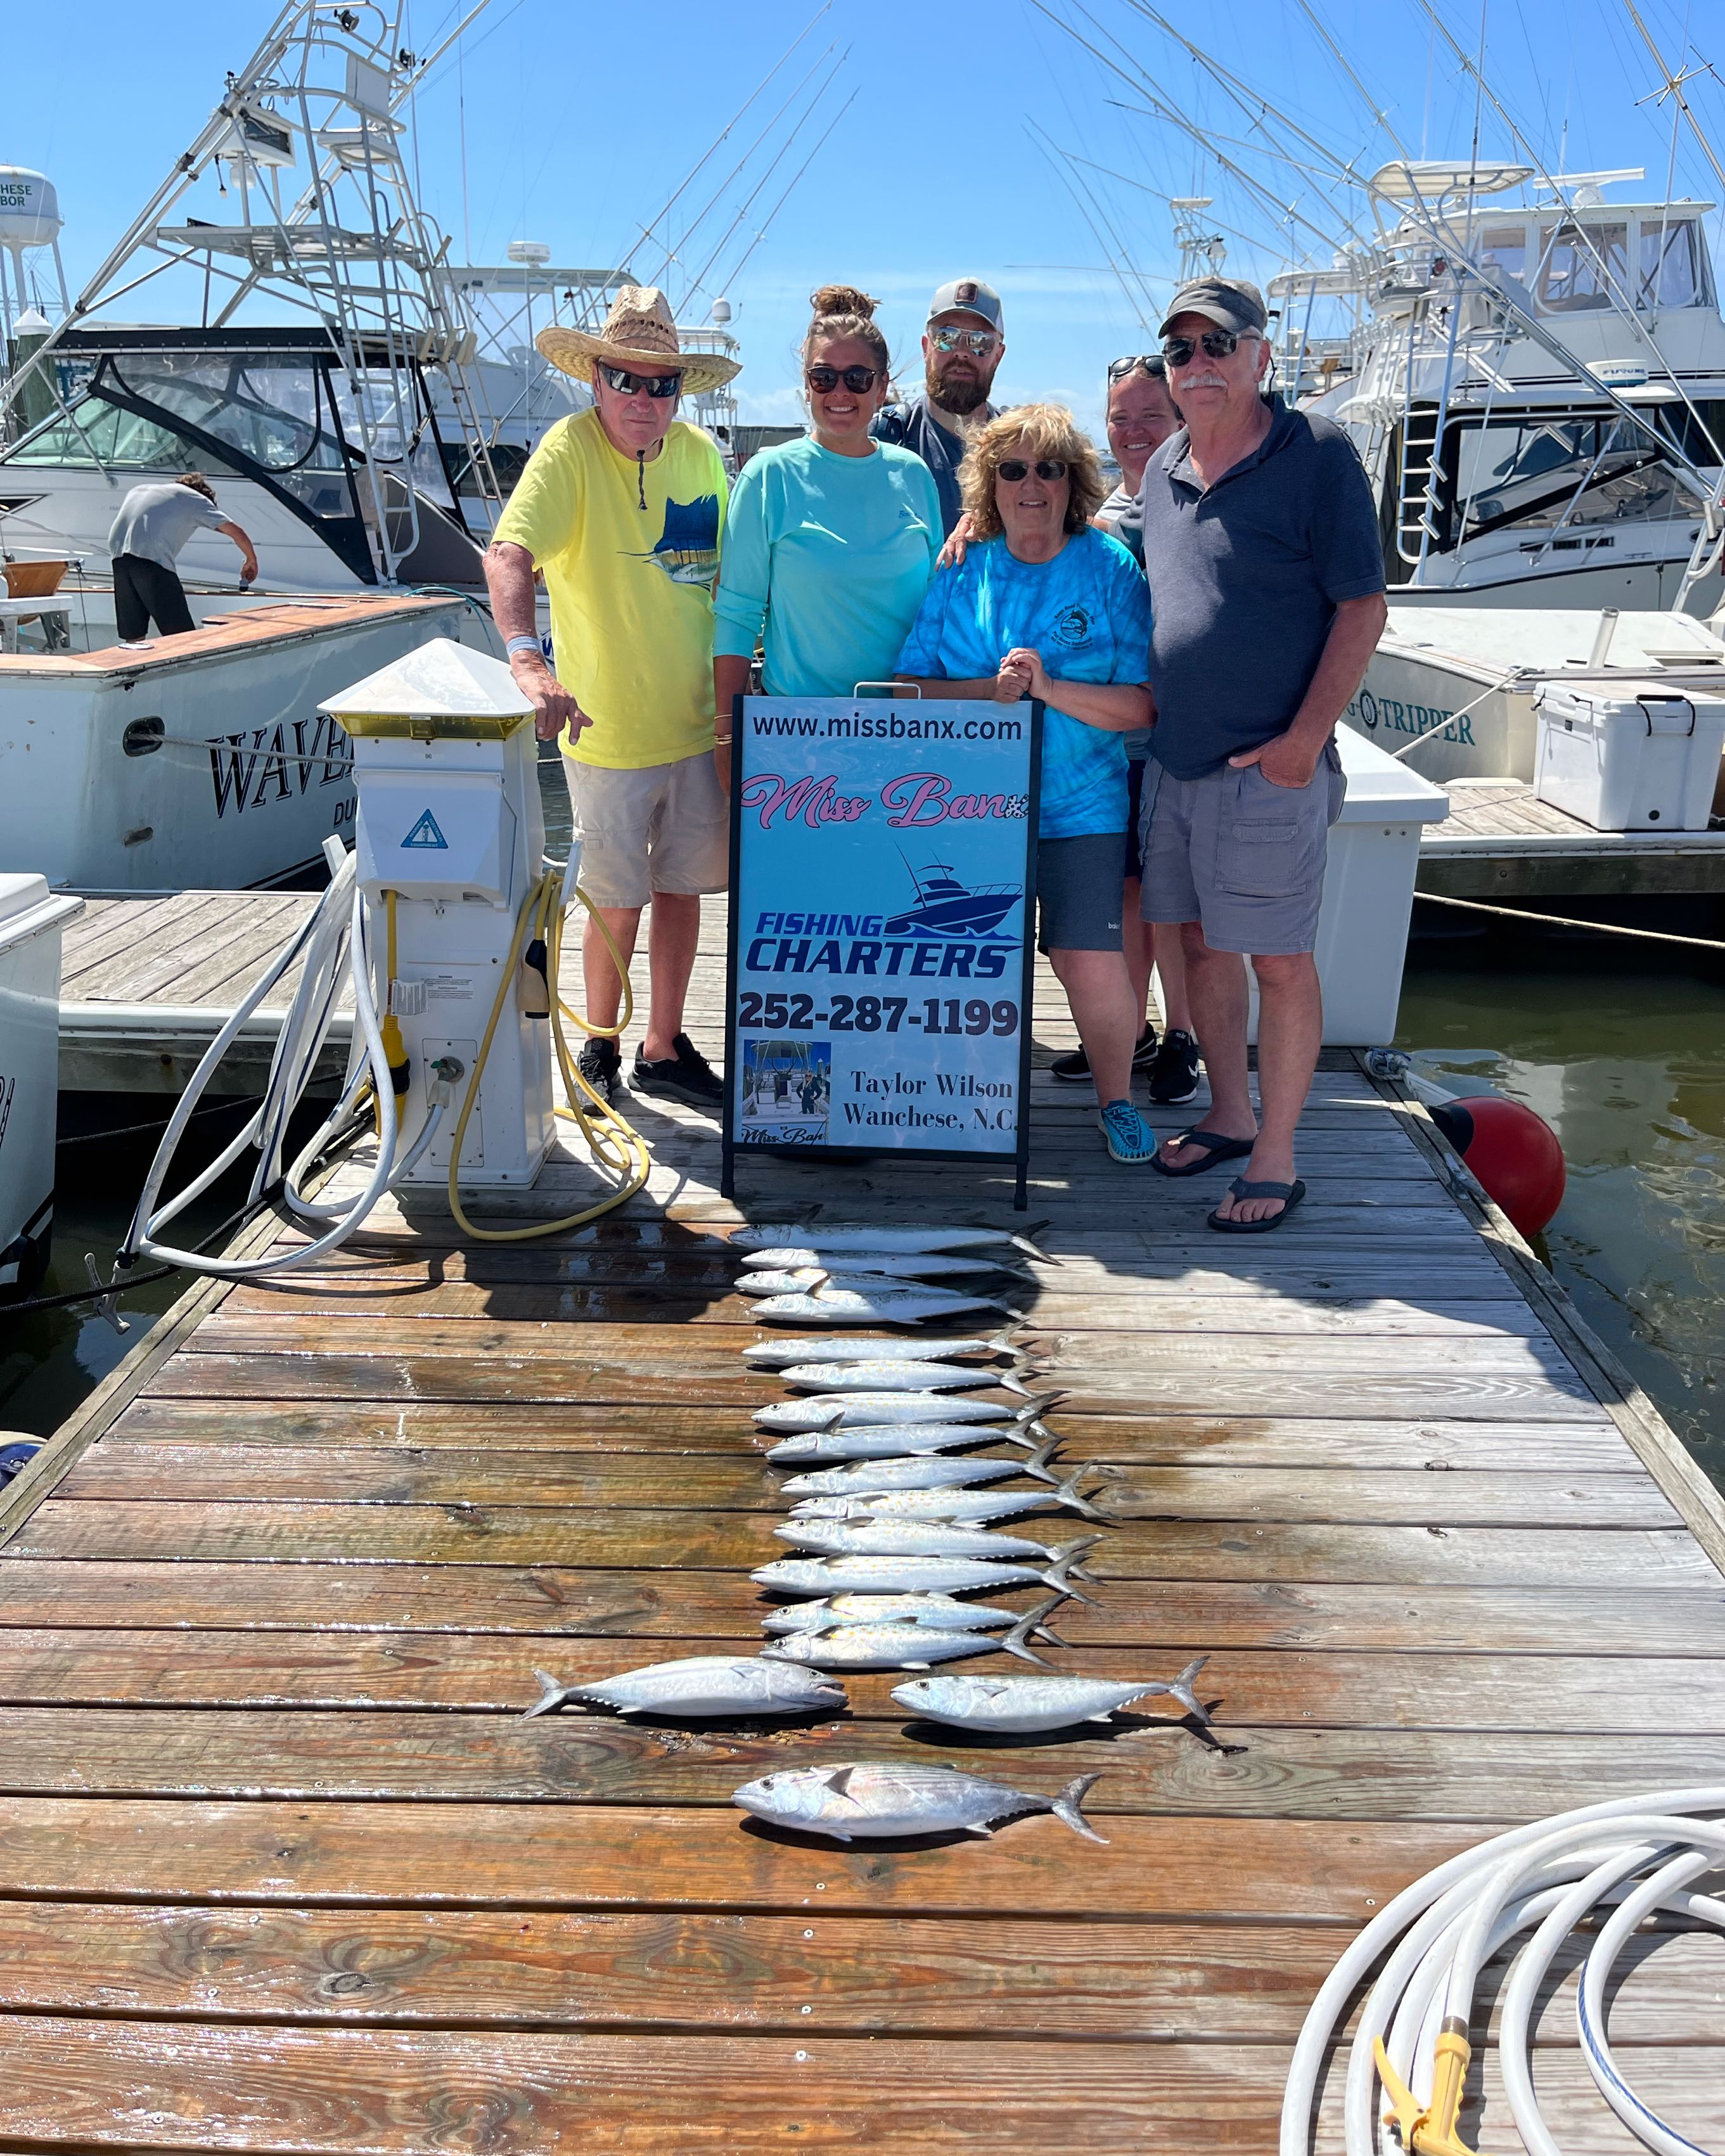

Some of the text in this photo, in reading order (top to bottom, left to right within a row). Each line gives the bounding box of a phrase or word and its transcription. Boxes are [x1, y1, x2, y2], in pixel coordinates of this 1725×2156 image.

[753, 712, 1022, 740] www.missbanx.com
[1378, 698, 1476, 747] TRIPPER
[205, 714, 355, 818] WAVE
[741, 773, 871, 829] Miss
[755, 912, 883, 937] FISHING
[745, 939, 1024, 979] CHARTERS
[738, 992, 1018, 1036] 252-287-1199
[851, 1071, 1013, 1101] Taylor Wilson
[843, 1103, 1018, 1133] Wanchese, N.C.
[783, 1127, 826, 1145] Ban
